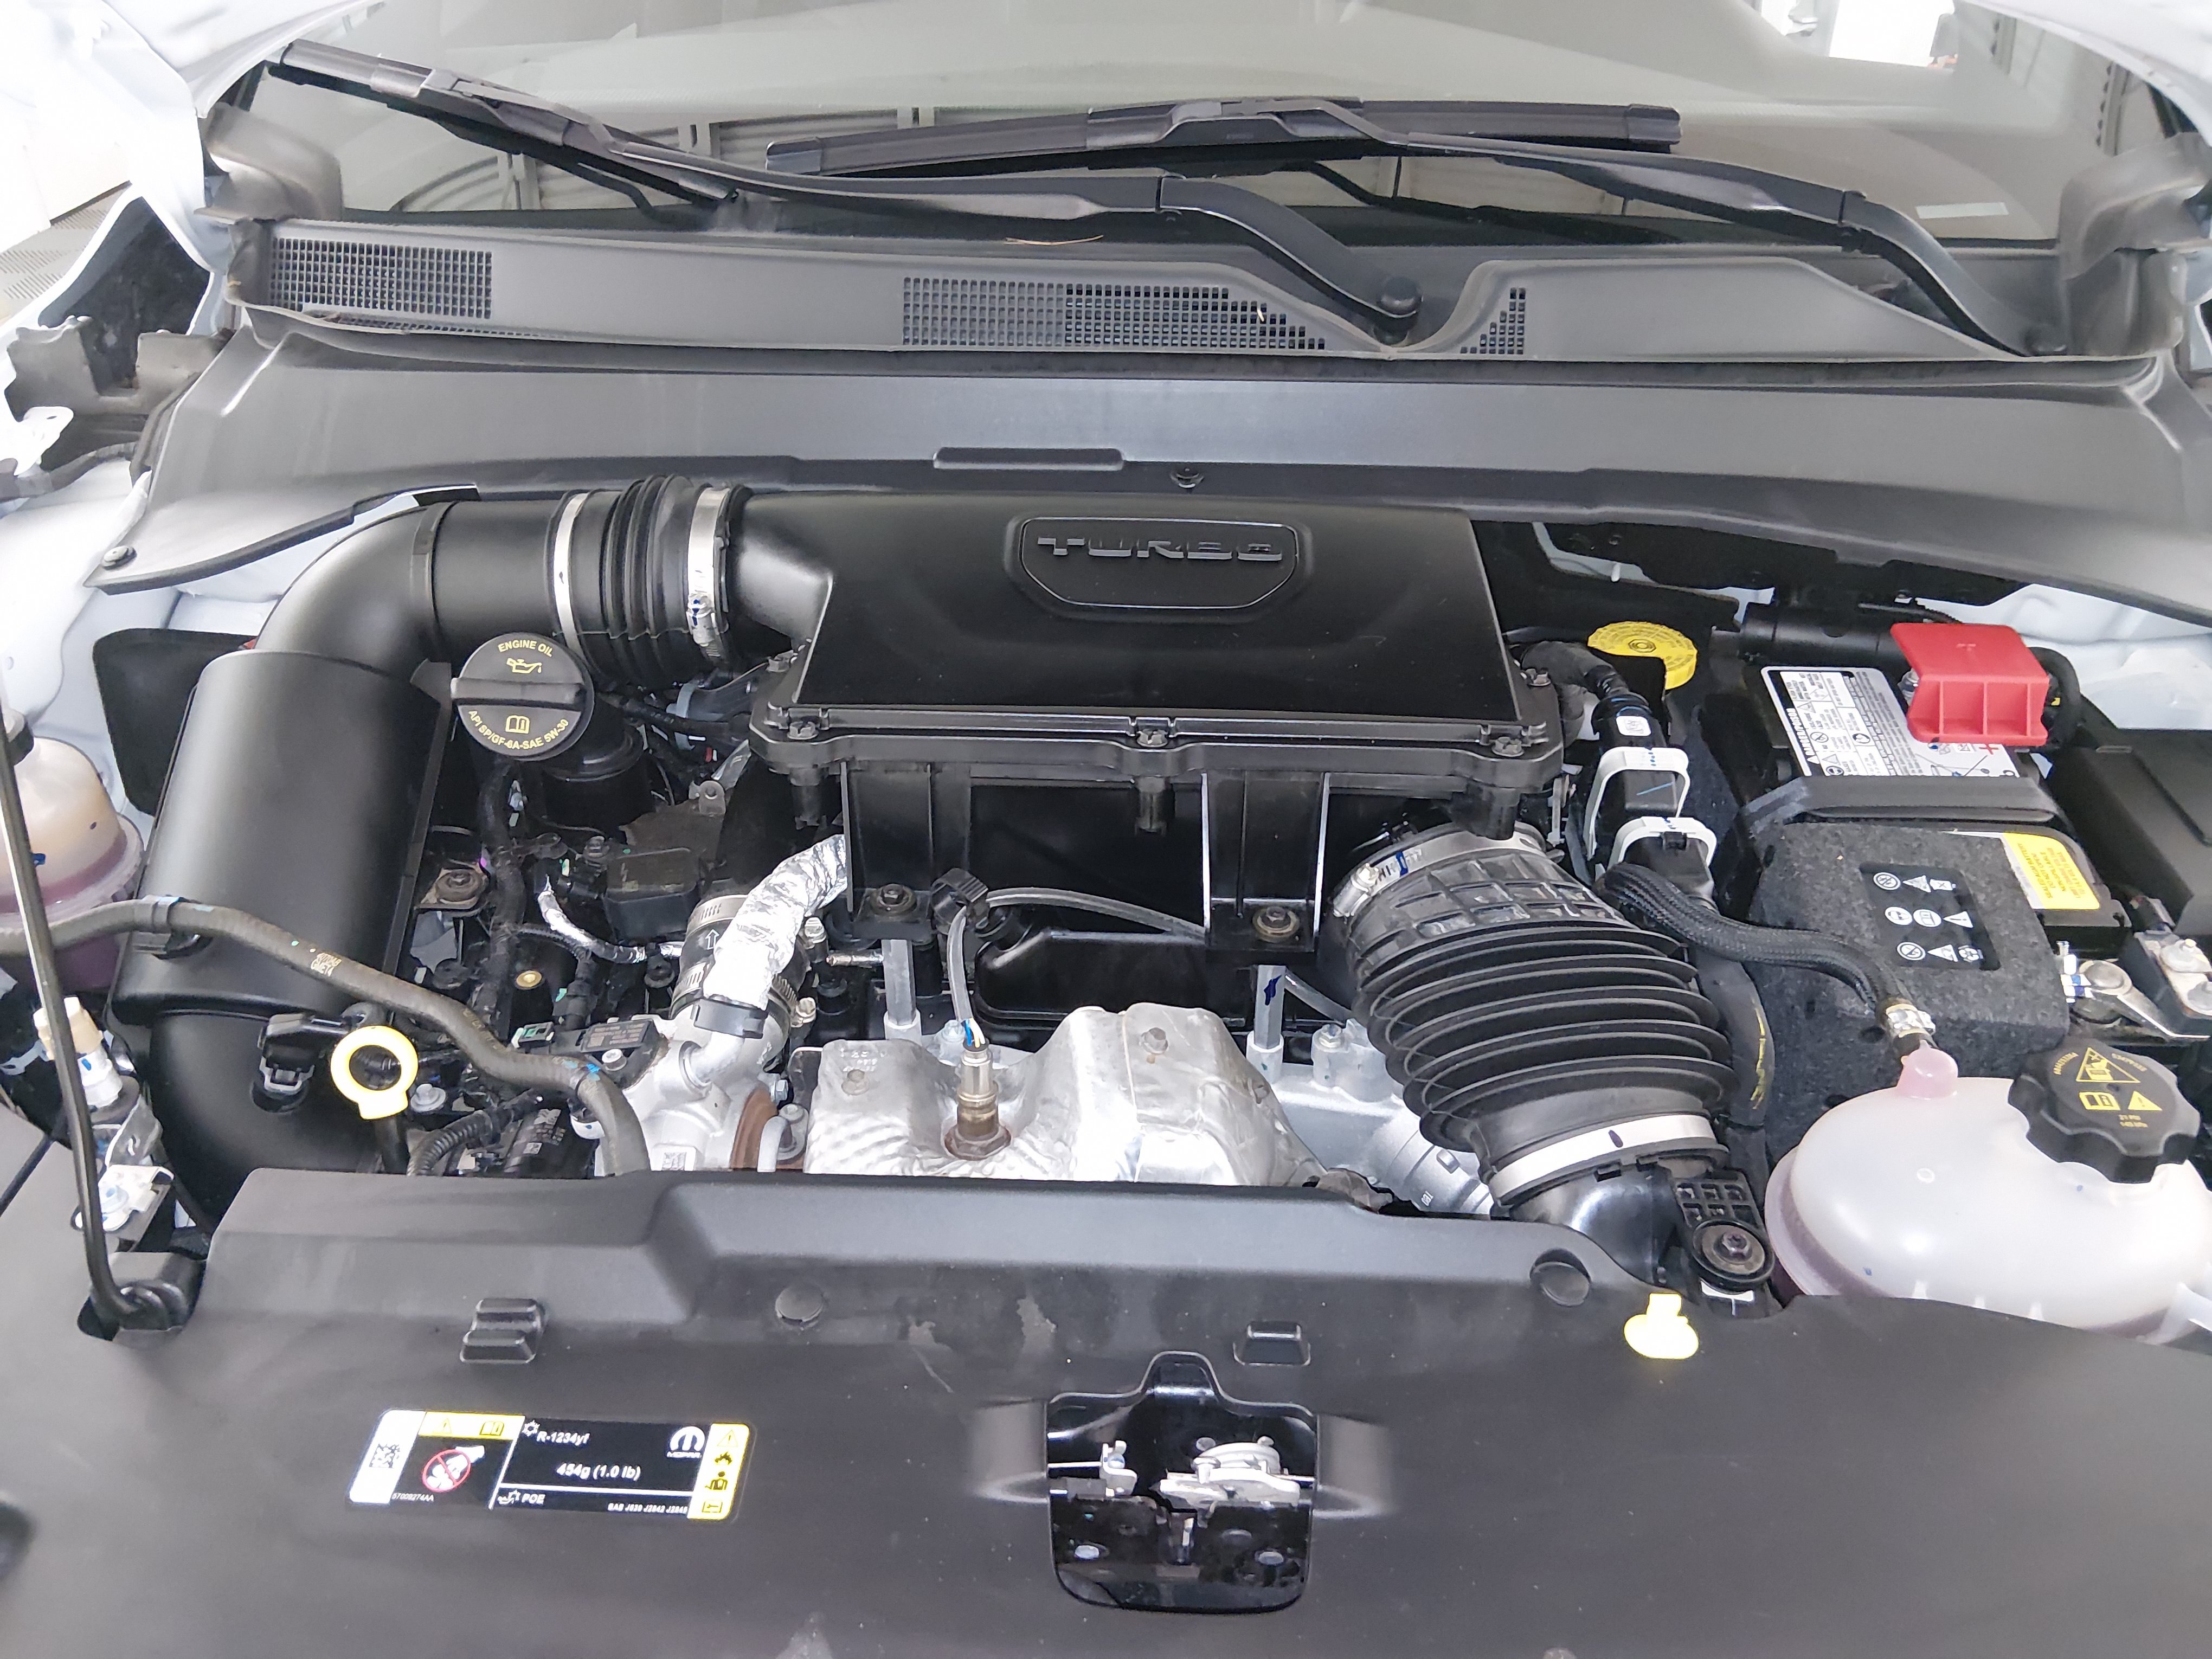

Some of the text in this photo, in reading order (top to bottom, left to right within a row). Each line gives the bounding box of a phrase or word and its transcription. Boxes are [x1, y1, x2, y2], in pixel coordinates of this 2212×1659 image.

[1037, 537, 1283, 561] TURBO
[498, 640, 552, 657] ENGINE OIL
[468, 710, 483, 727] API
[544, 719, 569, 743] 5W-30
[536, 1431, 590, 1446] R-1234yf
[556, 1463, 642, 1481] 454g (1.0 lb)
[522, 1493, 546, 1504] POE
